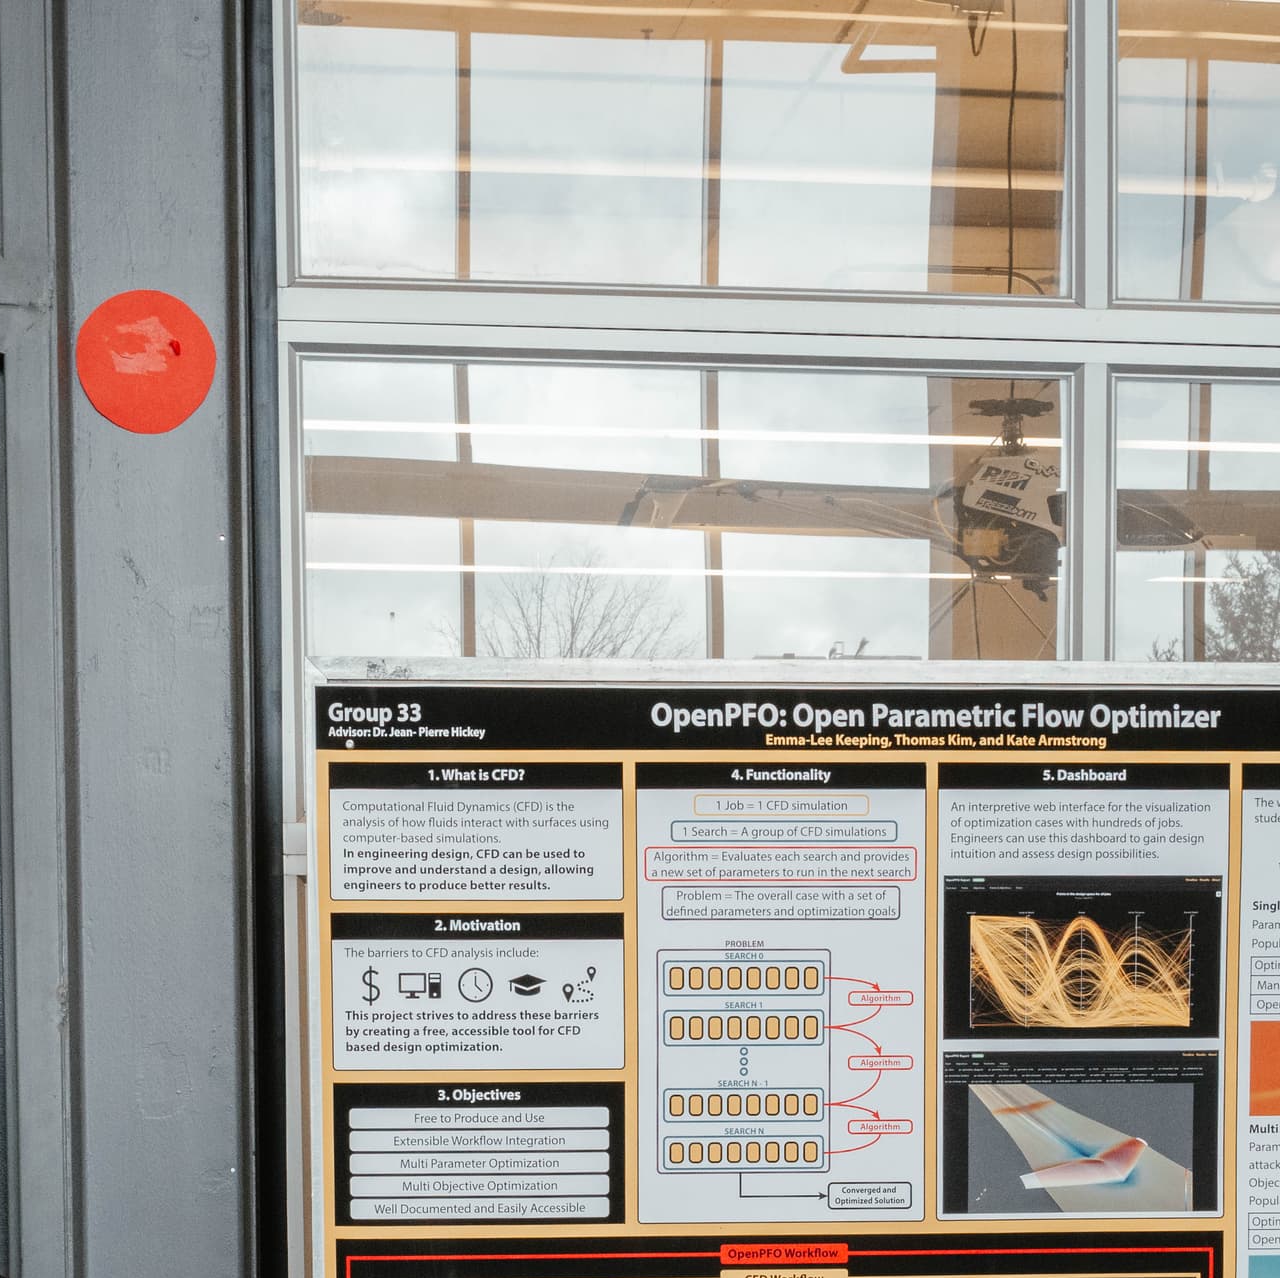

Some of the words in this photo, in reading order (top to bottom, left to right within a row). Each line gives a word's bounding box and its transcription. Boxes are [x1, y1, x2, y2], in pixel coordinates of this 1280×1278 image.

[327, 702, 393, 727] Group
[396, 702, 422, 723] 33
[650, 702, 788, 733] OpenPFO:
[792, 702, 865, 733] Open
[871, 703, 1016, 728] Parametric
[1022, 703, 1084, 728] Flow
[1090, 703, 1222, 734] Optimizer
[328, 726, 372, 738] Advisor:
[372, 726, 388, 738] Dr.
[388, 726, 417, 738] Jean-
[418, 726, 450, 738] Pierre
[450, 726, 486, 740] Hickey
[765, 733, 832, 746] Emma-Lee
[835, 734, 892, 748] Keeping,
[894, 733, 946, 746] Thomas
[948, 734, 977, 748] Kim,
[979, 734, 1004, 746] and
[1006, 734, 1036, 746] Kate
[1038, 734, 1108, 750] Armstrong
[427, 769, 440, 781] 1.
[441, 768, 477, 781] What
[478, 768, 490, 782] is
[491, 768, 526, 781] CFD?
[730, 768, 744, 781] 4.
[745, 767, 832, 784] Functionality
[1042, 769, 1055, 781] 5.
[1056, 768, 1127, 782] Dashboard
[342, 800, 426, 814] Computational
[427, 800, 454, 813] Fluid
[456, 801, 511, 815] Dynamics
[513, 800, 543, 813] (CFD)
[545, 801, 554, 812] is
[556, 800, 575, 812] the
[434, 919, 448, 932] 2.
[449, 918, 521, 932] Motivation
[437, 1089, 451, 1101] 3.
[452, 1088, 522, 1104] Objectives
[414, 1113, 438, 1124] Free
[440, 1114, 452, 1124] to
[454, 1111, 499, 1124] Produce
[501, 1111, 522, 1123] and
[524, 1112, 545, 1123] Use
[393, 1135, 450, 1147] Extensible
[451, 1134, 503, 1147] Workflow
[505, 1135, 566, 1148] Integration
[400, 1158, 428, 1169] Multi
[430, 1157, 487, 1170] Parameter
[488, 1158, 560, 1171] Optimization
[402, 1180, 430, 1192] Multi
[432, 1179, 485, 1194] Objective
[487, 1180, 558, 1193] Optimization
[374, 1203, 399, 1215] Well
[400, 1202, 472, 1215] Documented
[473, 1202, 495, 1214] and
[497, 1202, 528, 1217] Easily
[530, 1201, 586, 1214] Accessible
[727, 1248, 782, 1261] OpenPFO
[784, 1248, 838, 1258] Workflow
